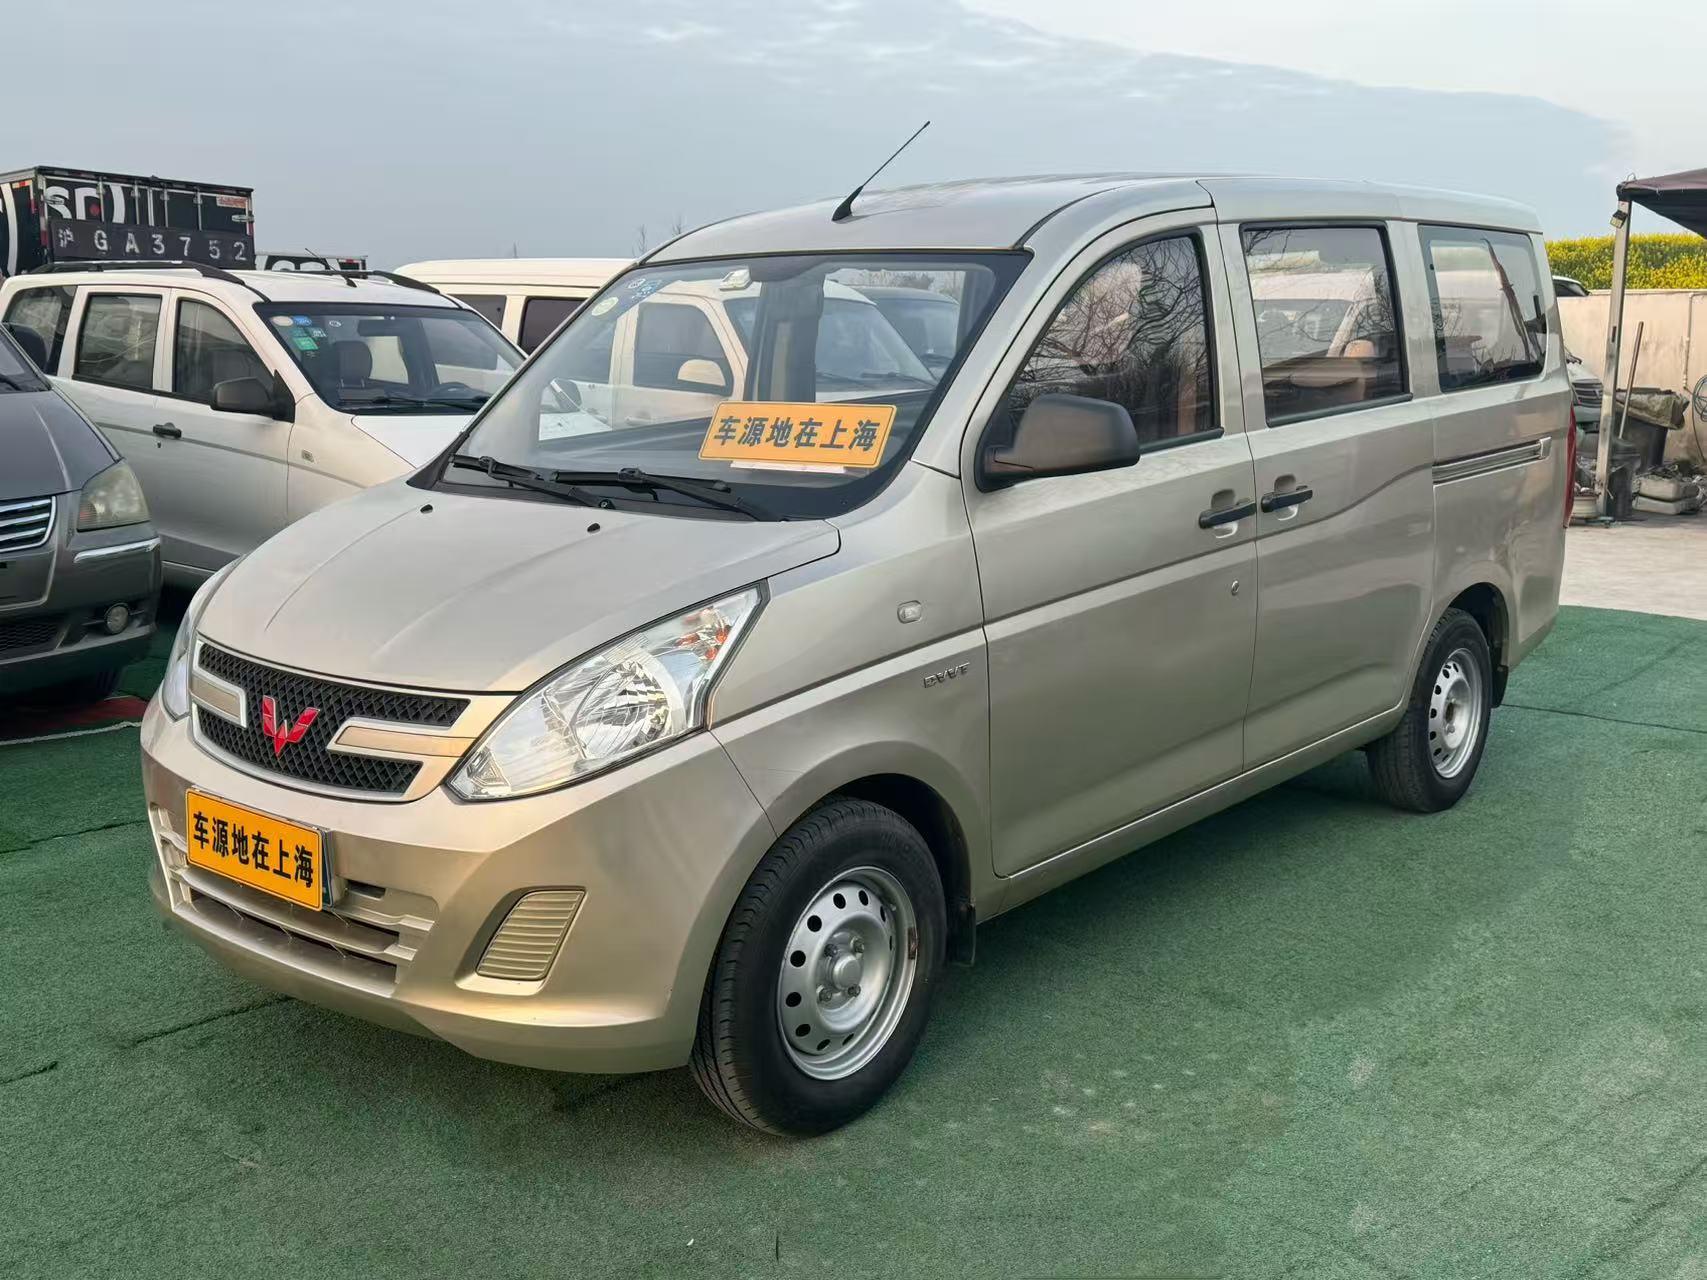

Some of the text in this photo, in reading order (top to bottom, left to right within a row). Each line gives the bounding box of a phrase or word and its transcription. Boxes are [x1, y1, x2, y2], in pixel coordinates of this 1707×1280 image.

[714, 415, 881, 452] 车源地在上海
[192, 811, 314, 889] 车源地在上海
